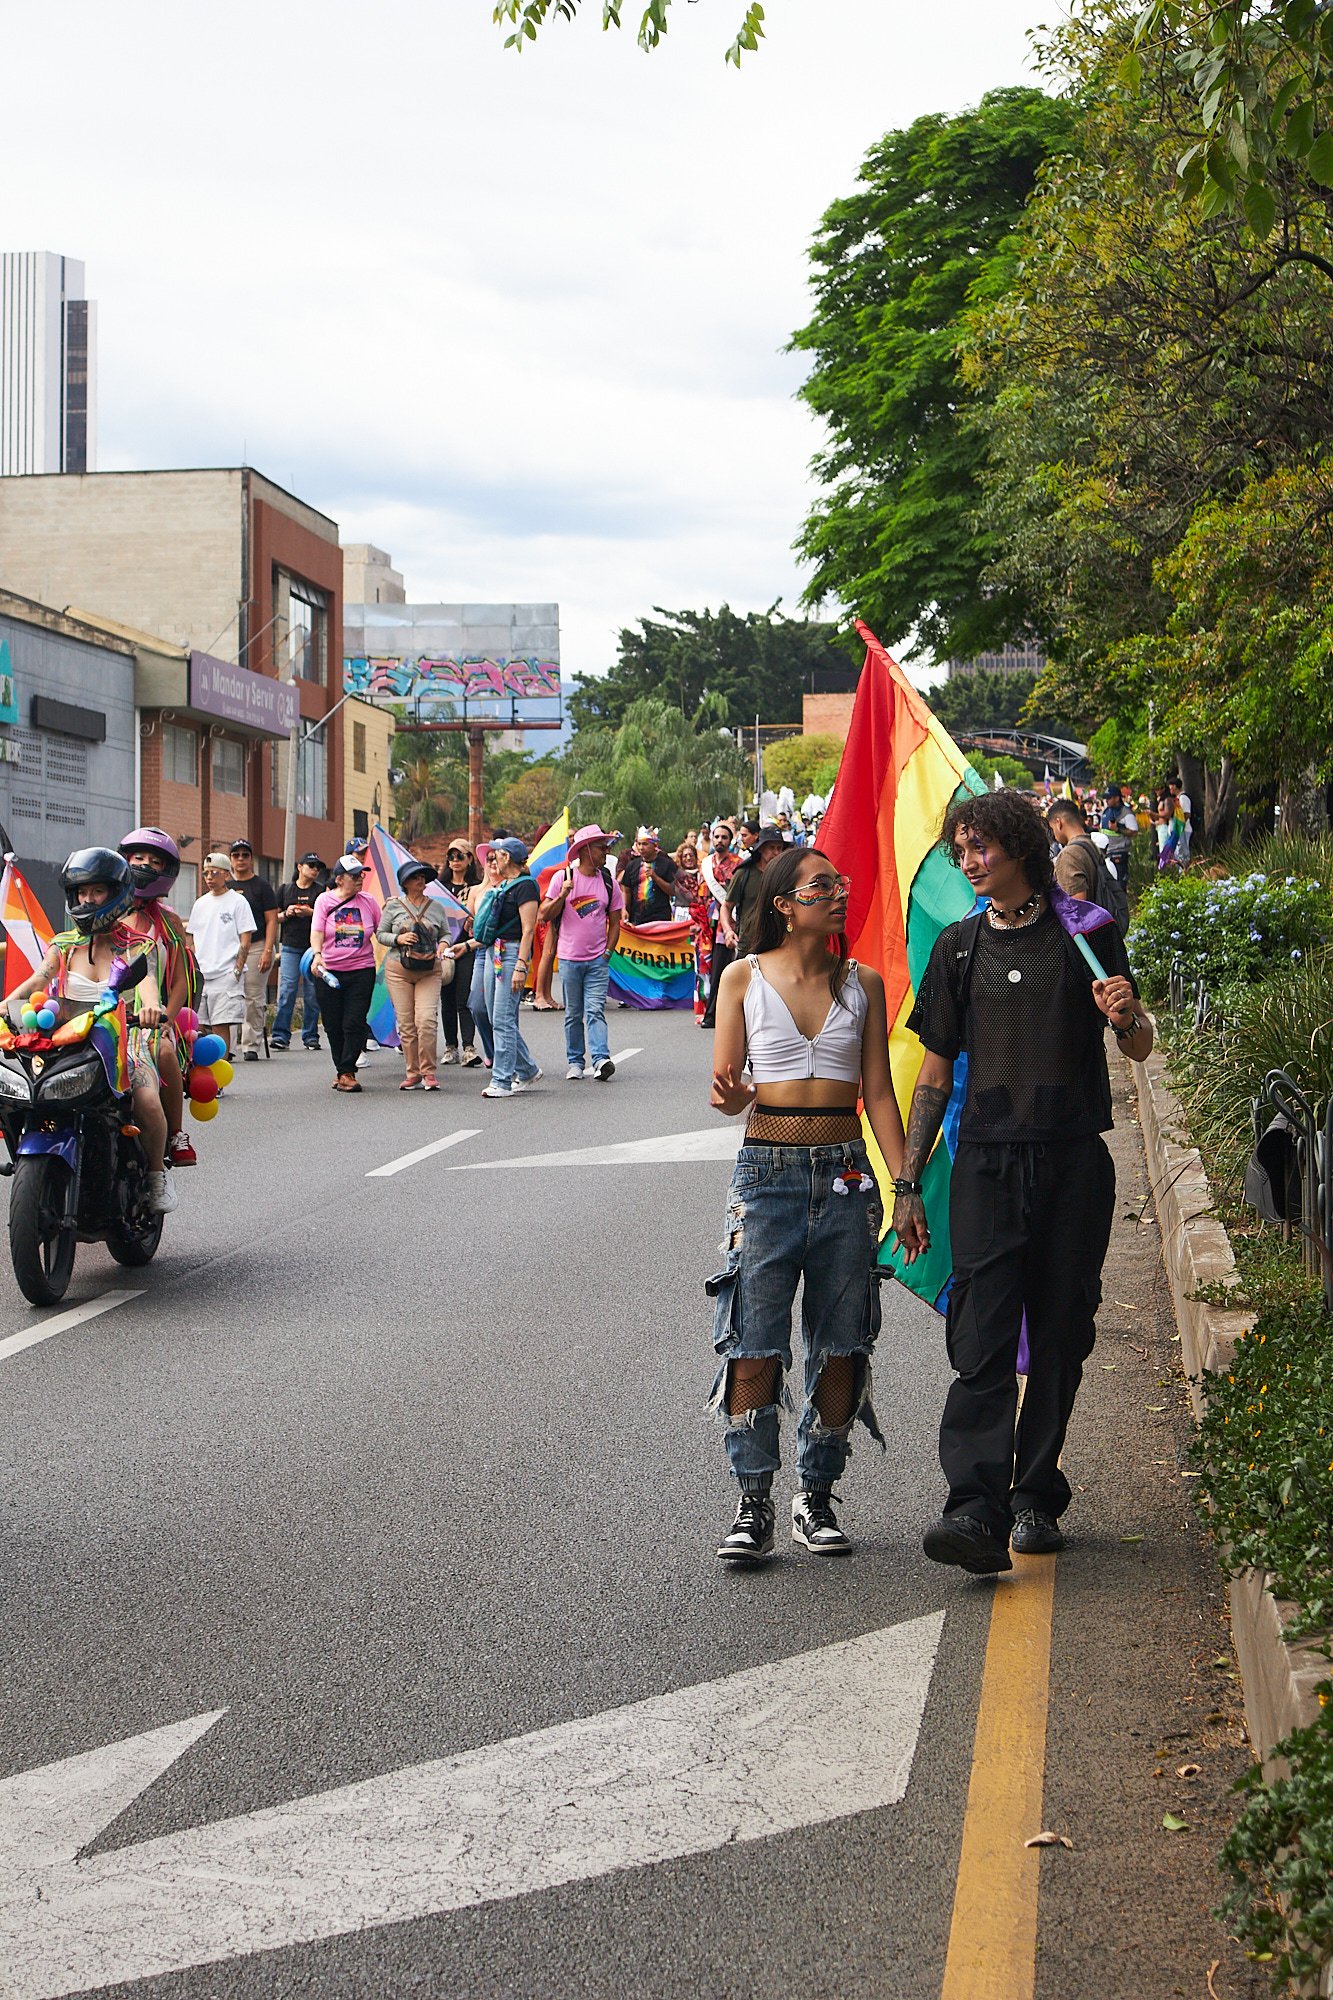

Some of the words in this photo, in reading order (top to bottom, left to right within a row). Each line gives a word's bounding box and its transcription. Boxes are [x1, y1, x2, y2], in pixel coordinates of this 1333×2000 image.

[212, 666, 244, 701] Mandar
[245, 684, 251, 709] y
[252, 681, 274, 711] Servir
[285, 694, 294, 716] 24
